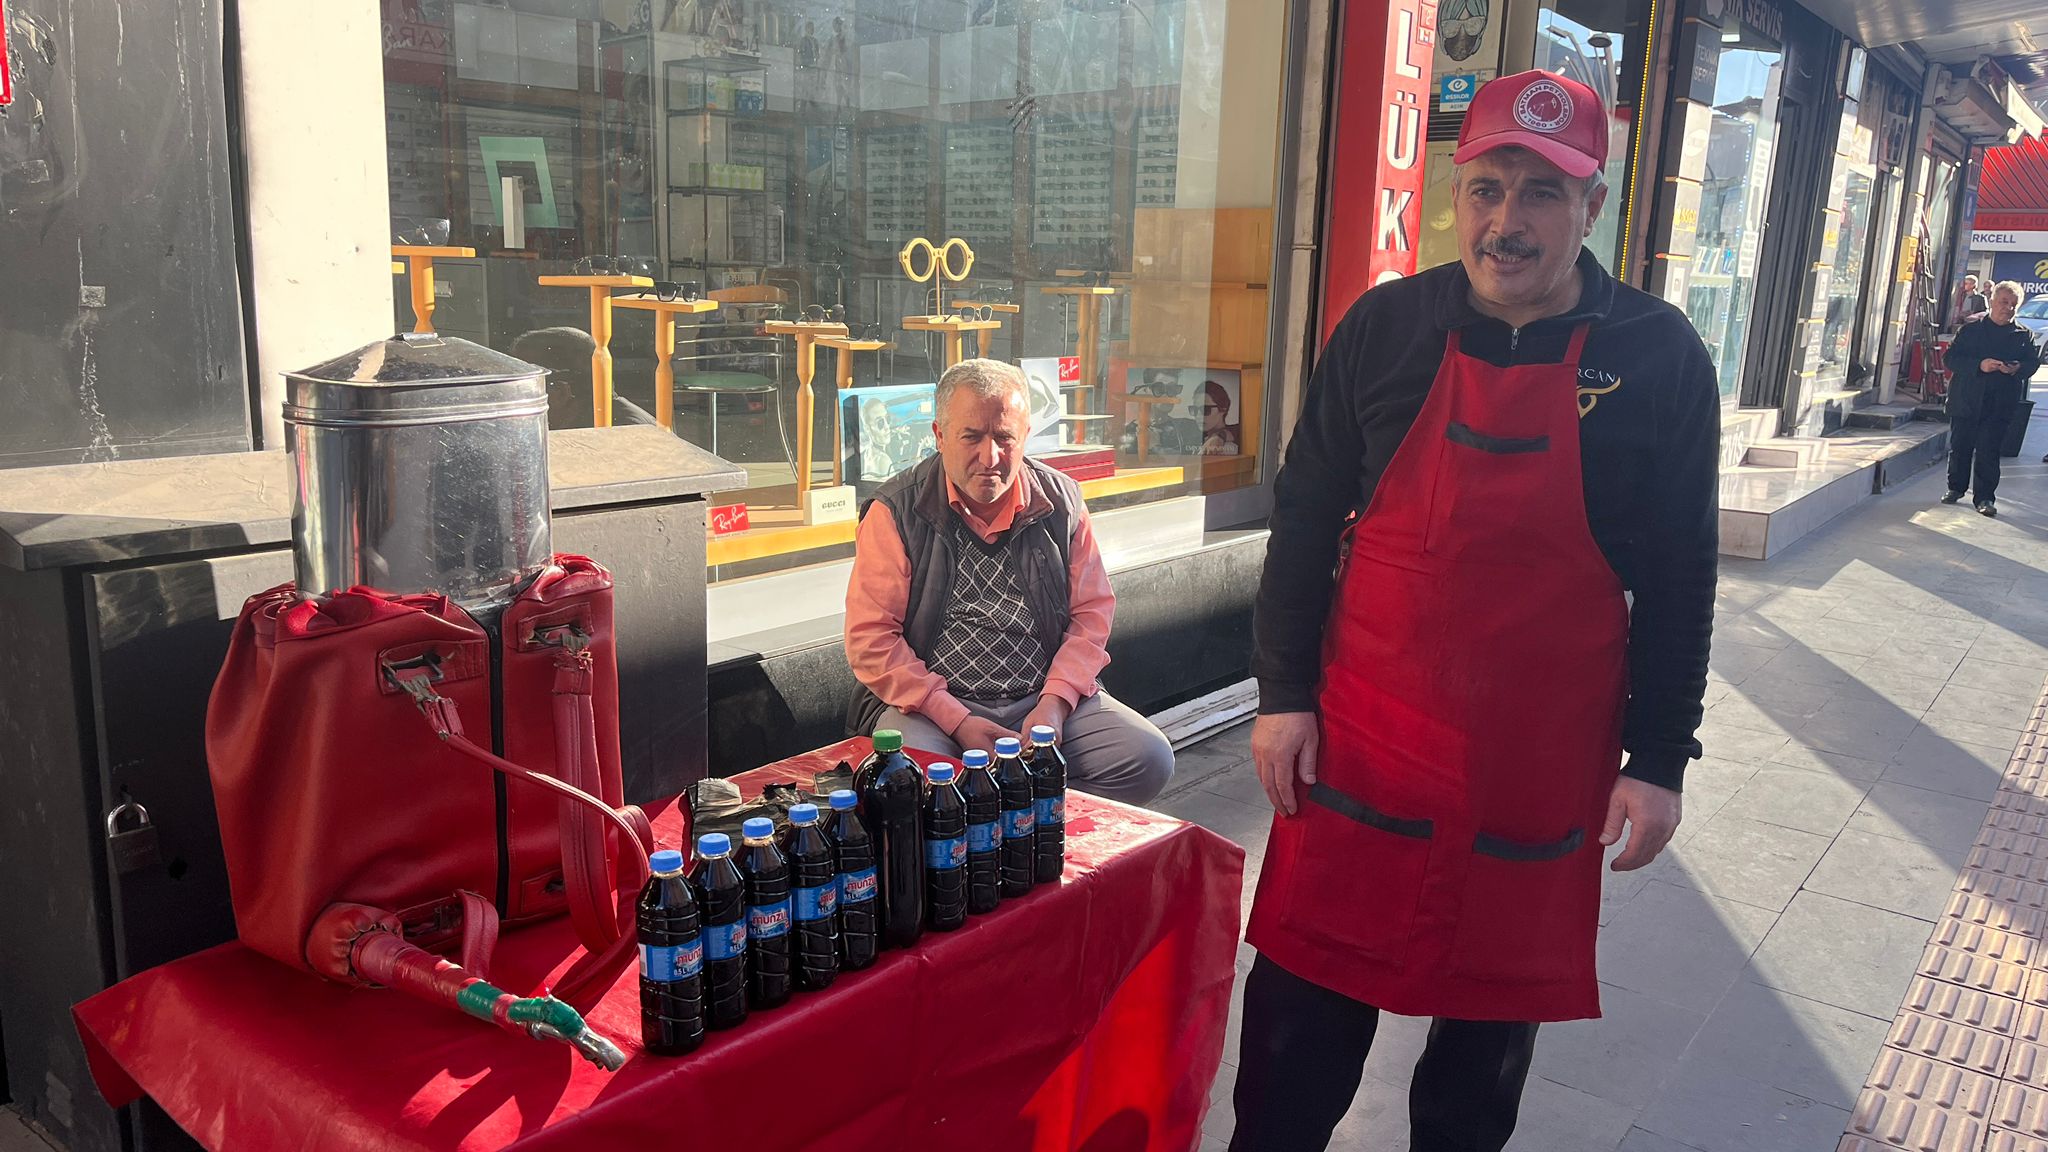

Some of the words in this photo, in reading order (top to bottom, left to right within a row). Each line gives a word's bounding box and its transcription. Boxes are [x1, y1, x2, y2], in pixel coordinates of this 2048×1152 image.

[1520, 85, 1542, 115] BATMAN
[1543, 85, 1568, 126] PETROLSPOR
[1377, 9, 1421, 287] LÜK
[713, 504, 746, 531] Ray-Ban
[821, 500, 846, 510] GUCCI
